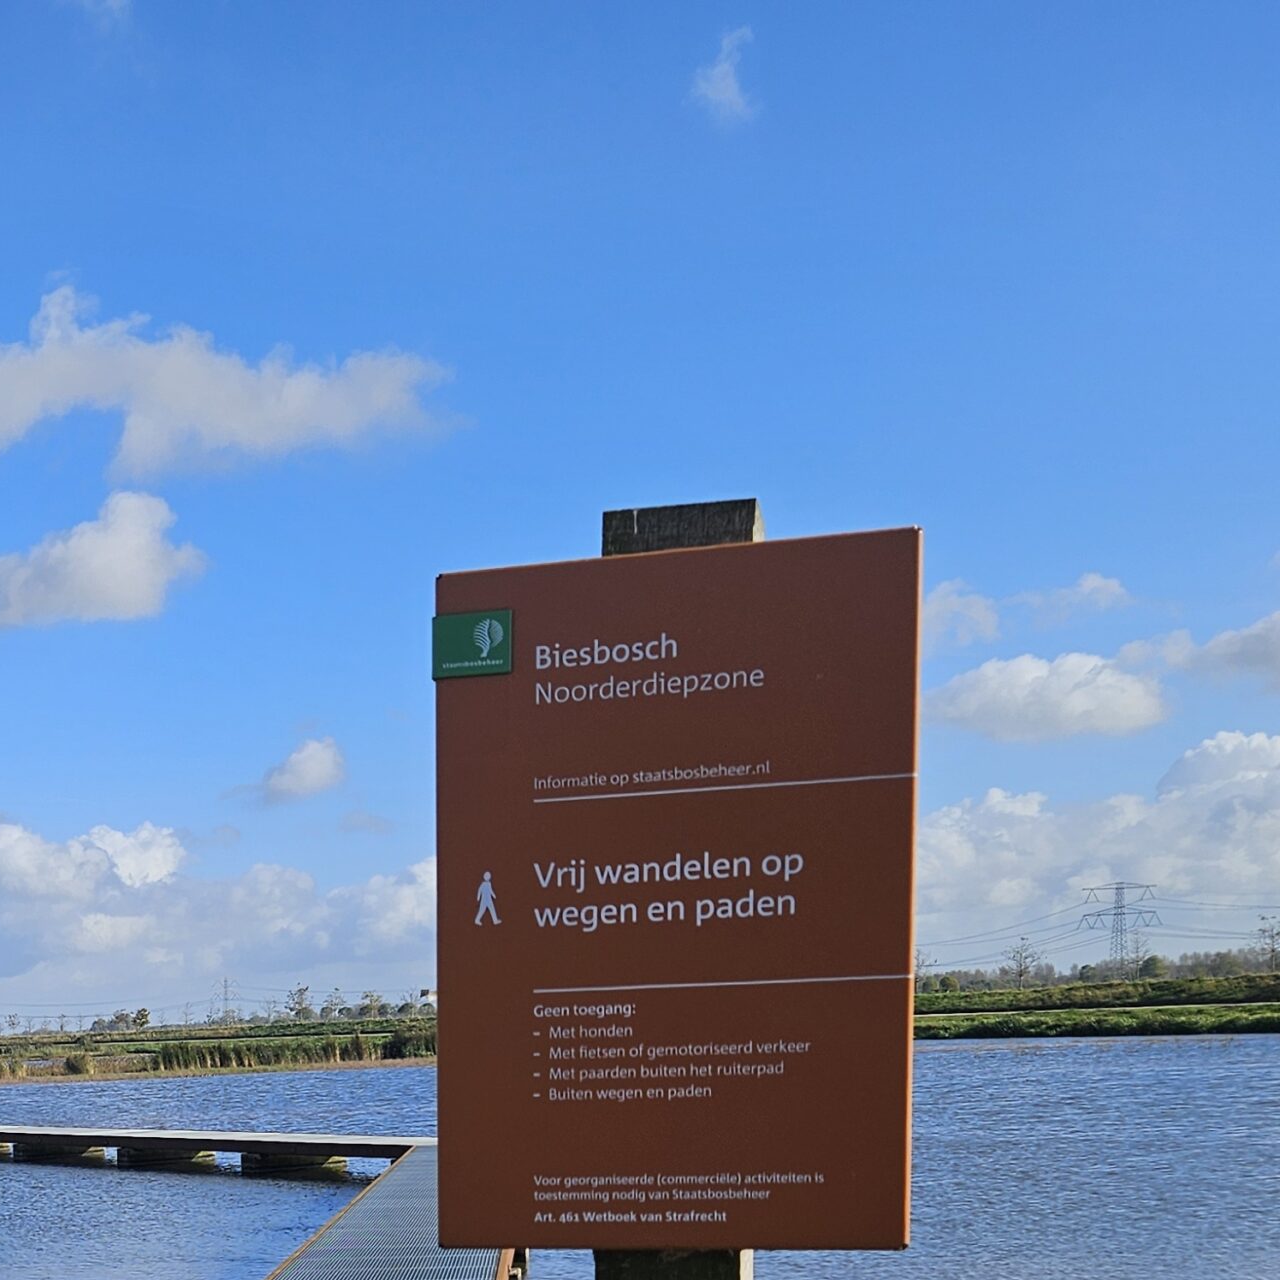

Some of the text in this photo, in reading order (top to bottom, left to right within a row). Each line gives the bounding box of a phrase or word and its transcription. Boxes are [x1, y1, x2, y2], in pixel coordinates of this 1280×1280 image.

[536, 633, 677, 669] Biesbosch
[535, 668, 765, 704] Noorderdiepzone
[534, 760, 770, 789] Informatie op staatsbosbeheer.nl
[534, 852, 803, 893] Vrij wandelen op
[534, 889, 795, 932] wegen en paden
[533, 1004, 635, 1018] Geen toegang:
[548, 1025, 576, 1039] Met
[579, 1023, 633, 1038] honden
[548, 1046, 576, 1060] Met
[579, 1045, 626, 1060] fietsen
[628, 1043, 644, 1058] of
[646, 1039, 753, 1061] gemotoriseerd
[756, 1039, 811, 1054] verkeer
[549, 1067, 575, 1081] Met
[579, 1064, 637, 1083] paarden
[640, 1064, 687, 1079] buiten
[689, 1063, 713, 1077] het
[716, 1060, 784, 1078] ruiterpad
[548, 1087, 593, 1101] Buiten
[596, 1088, 643, 1103] wegen
[646, 1087, 665, 1099] en
[667, 1083, 712, 1101] paden
[533, 1171, 825, 1189] Voor georganiseerde (commerciële) activiteiten is
[533, 1187, 771, 1203] toestemming nodig van Staatsbosbeheer
[533, 1209, 727, 1224] Art. 461 Wetboek van Strafrecht
